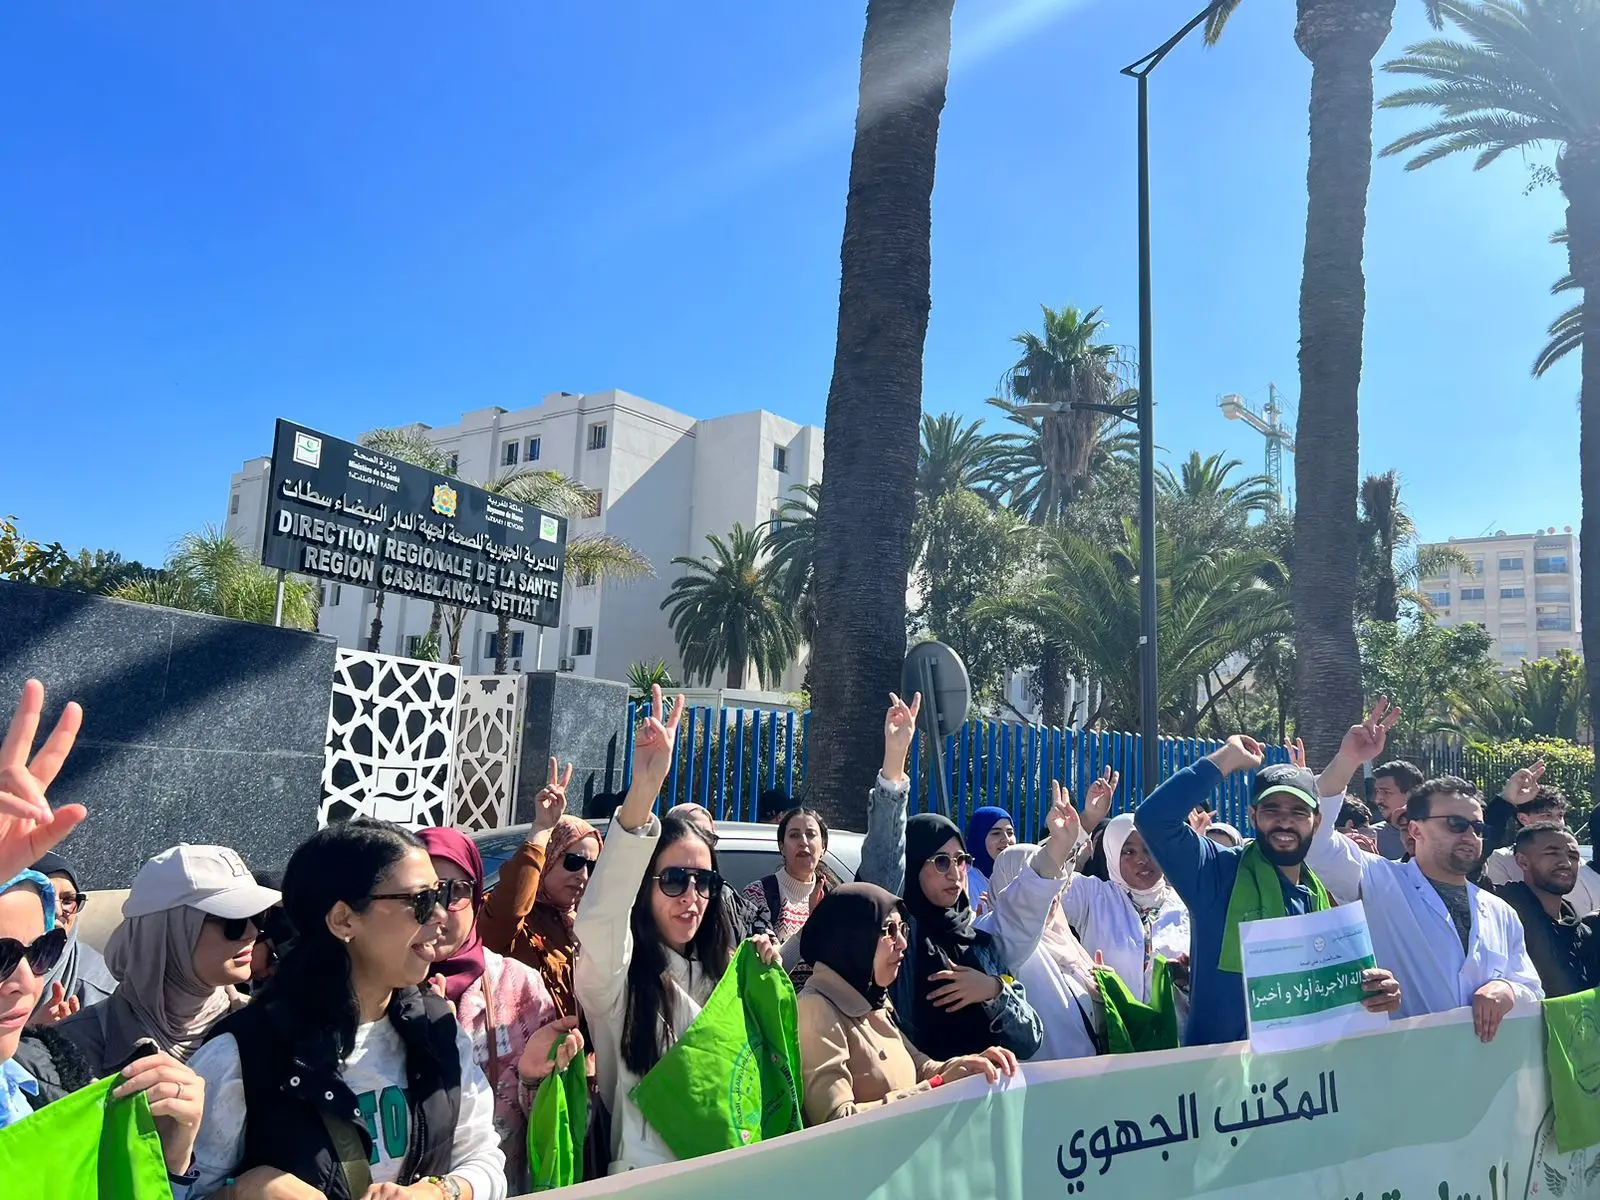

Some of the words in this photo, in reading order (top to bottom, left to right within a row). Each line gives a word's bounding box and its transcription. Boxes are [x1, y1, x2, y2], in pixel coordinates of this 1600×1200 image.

[353, 448, 379, 464] الصحة
[379, 457, 397, 472] وزارة
[282, 478, 333, 508] سطات
[334, 492, 388, 526] البيضاء
[387, 510, 417, 532] الدار
[418, 513, 446, 543] لجهة
[447, 523, 484, 550] للصحة
[278, 509, 380, 555] DIRECTION
[384, 537, 472, 578] REGIONALE
[476, 561, 497, 584] DE
[499, 567, 516, 589] LA
[518, 572, 559, 600] SANTE
[485, 534, 522, 563] الجهوية
[523, 545, 559, 572] المديرية
[304, 546, 375, 582] REGION
[381, 564, 481, 606] CASABLANCA
[491, 589, 540, 617] SETTAT
[1251, 982, 1282, 1007] أخيرا
[1285, 991, 1292, 1004] و
[1293, 978, 1313, 1001] أولا
[1314, 972, 1348, 996] الأجرية
[1213, 1070, 1339, 1147] المكتب
[1056, 1091, 1199, 1195] الجهوي
